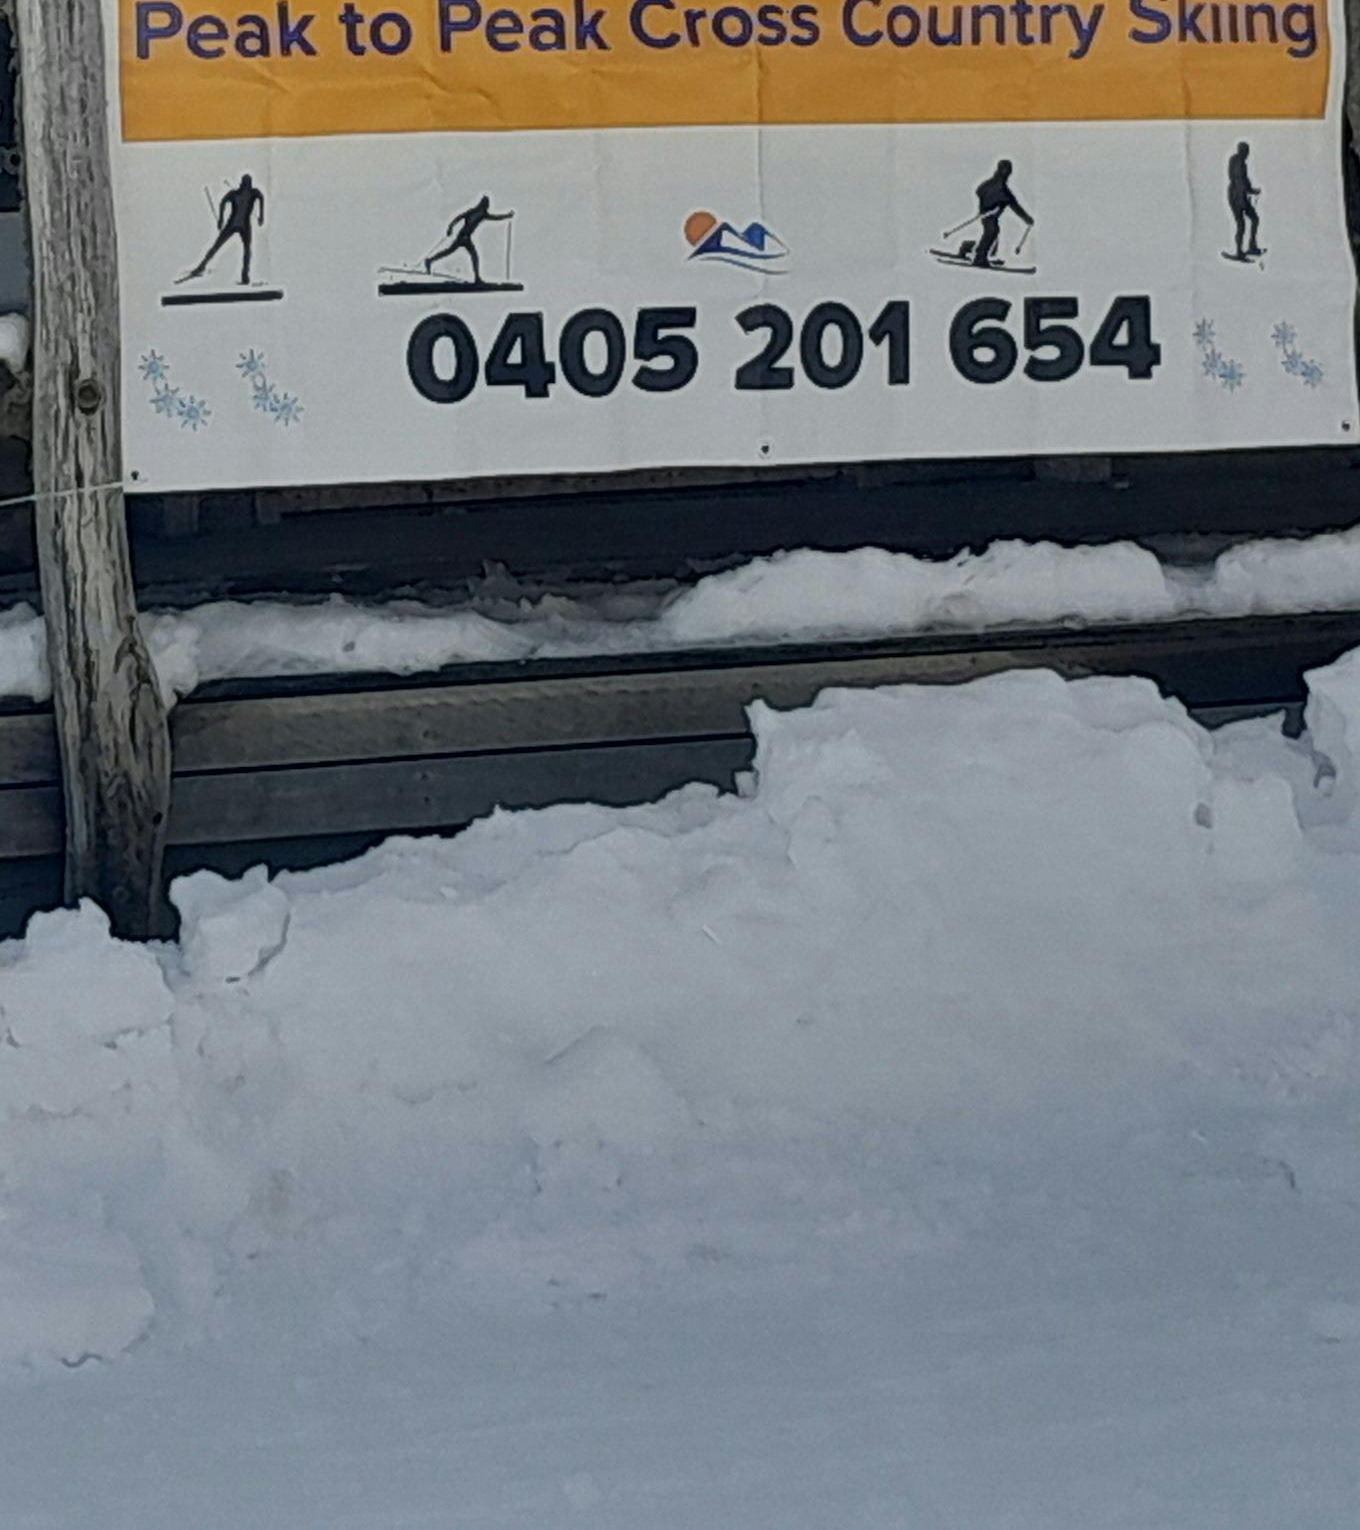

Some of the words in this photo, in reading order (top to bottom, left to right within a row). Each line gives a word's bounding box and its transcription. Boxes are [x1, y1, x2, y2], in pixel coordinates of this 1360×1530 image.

[135, 0, 317, 60] Peak
[338, 2, 413, 56] to
[406, 306, 699, 404] 0405
[734, 300, 910, 391] 201
[949, 295, 1161, 385] 654
